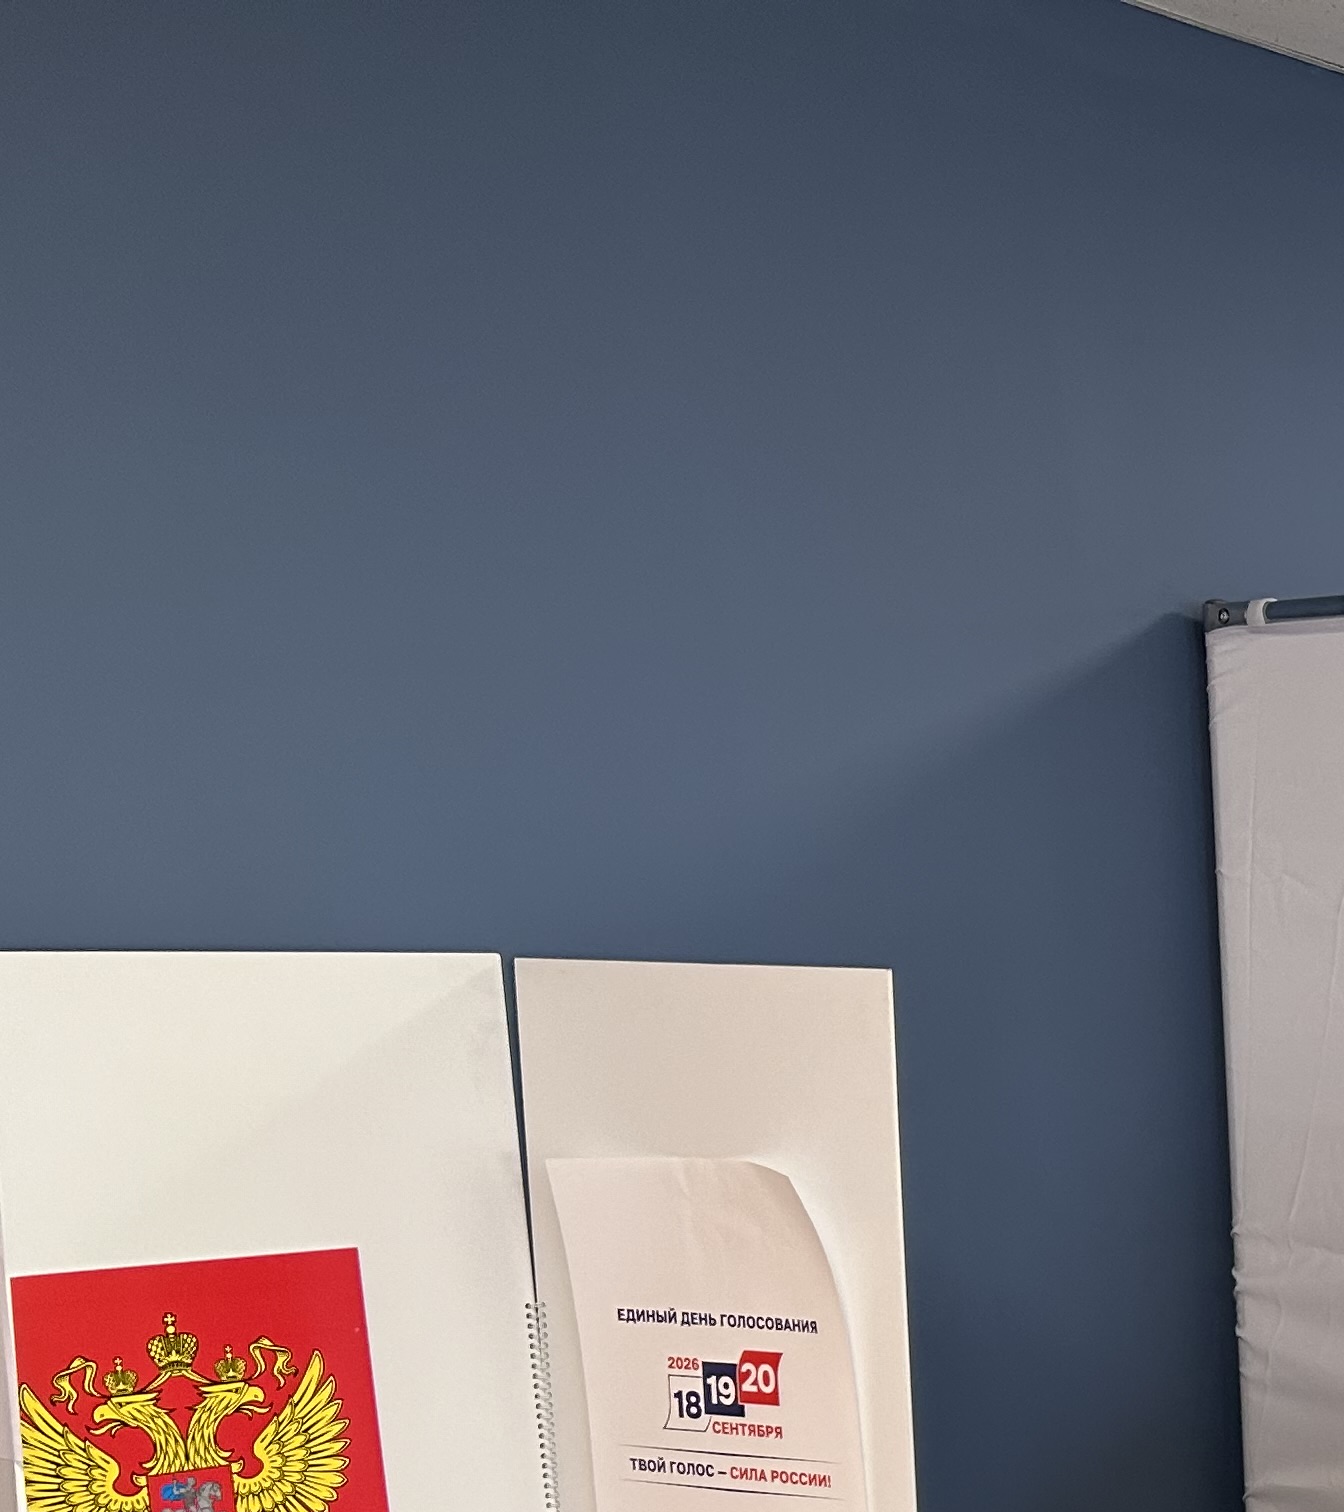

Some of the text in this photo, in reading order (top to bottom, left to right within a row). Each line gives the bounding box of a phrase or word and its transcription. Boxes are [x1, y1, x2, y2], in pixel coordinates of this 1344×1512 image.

[617, 1307, 818, 1334] ЕДИНЫЙ ДЕНЬ ГОЛОСОВАНИЯ
[667, 1356, 700, 1370] 2026
[674, 1363, 775, 1419] 18 19 20
[712, 1421, 784, 1440] СЕНТЯБРЯ
[630, 1457, 667, 1474] ТВОЙ
[670, 1461, 715, 1478] ГОЛОС
[730, 1466, 768, 1483] СИЛА
[771, 1470, 833, 1488] РОССИИ!
